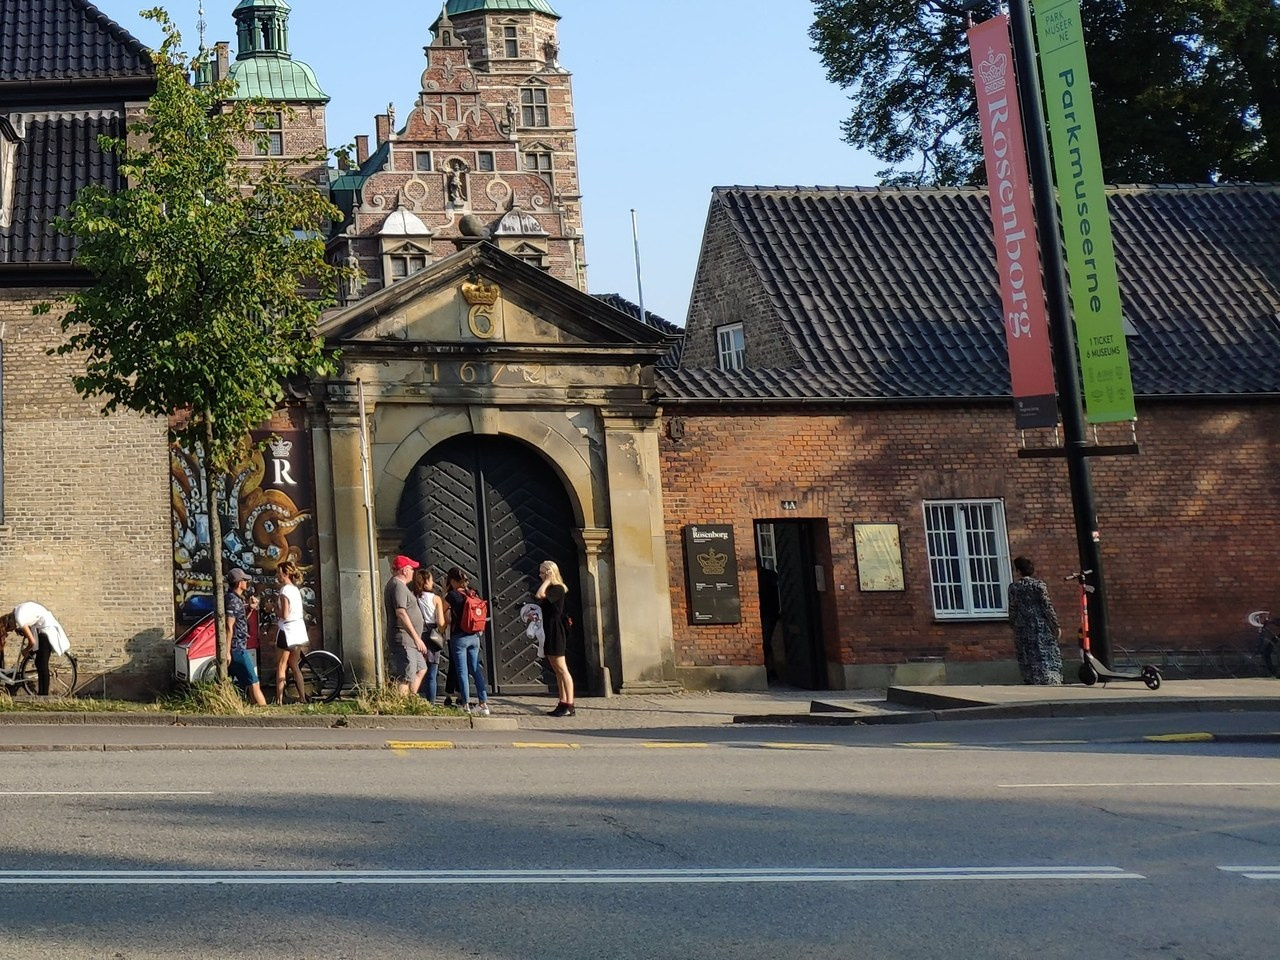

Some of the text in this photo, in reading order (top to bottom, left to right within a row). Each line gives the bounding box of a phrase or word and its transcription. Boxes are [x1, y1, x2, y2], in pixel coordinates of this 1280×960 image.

[1045, 10, 1065, 26] PARK
[1044, 17, 1073, 38] MUSEER
[1059, 30, 1070, 42] NE
[1058, 68, 1102, 314] Parkmuseerne
[987, 94, 1032, 339] Rosenborg
[1094, 334, 1114, 345] TICKET
[1086, 345, 1121, 359] 6 MUSEUMS
[271, 458, 298, 485] R
[783, 501, 797, 510] 4A
[692, 531, 729, 540] Rosenborg
